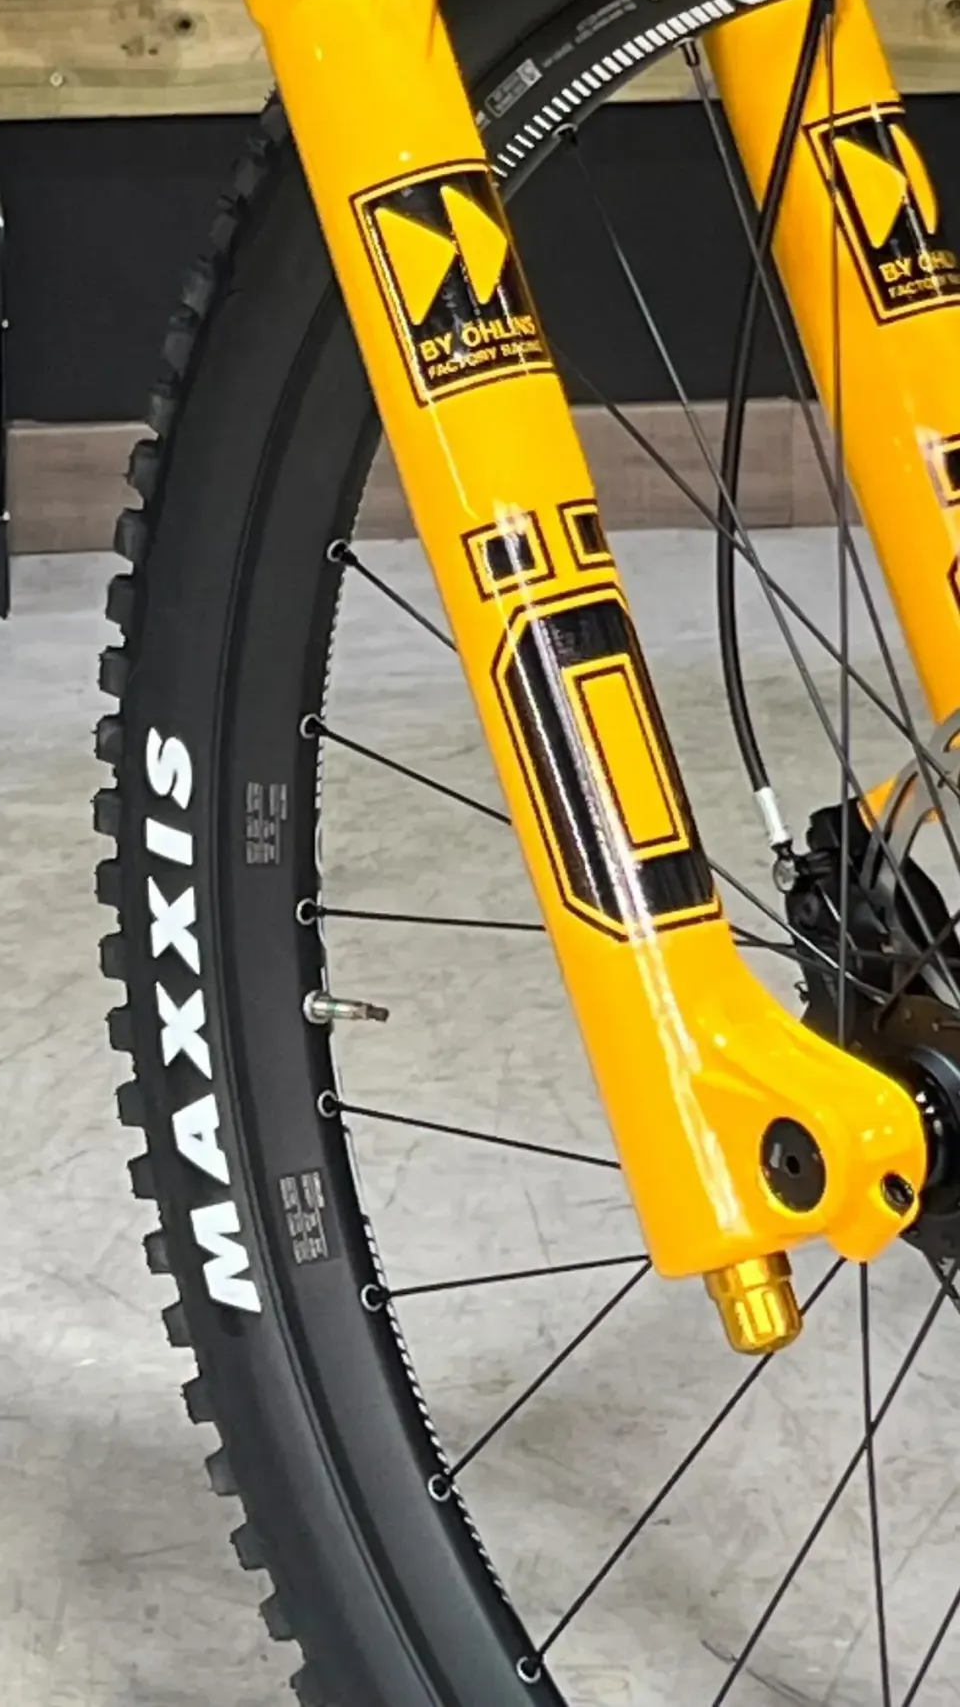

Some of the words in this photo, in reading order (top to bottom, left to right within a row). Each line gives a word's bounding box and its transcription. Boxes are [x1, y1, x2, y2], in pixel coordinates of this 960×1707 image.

[420, 332, 453, 362] BY
[461, 314, 536, 347] ÖHLINS
[428, 346, 498, 379] FACTORY
[145, 727, 262, 1314] MAXXIS
